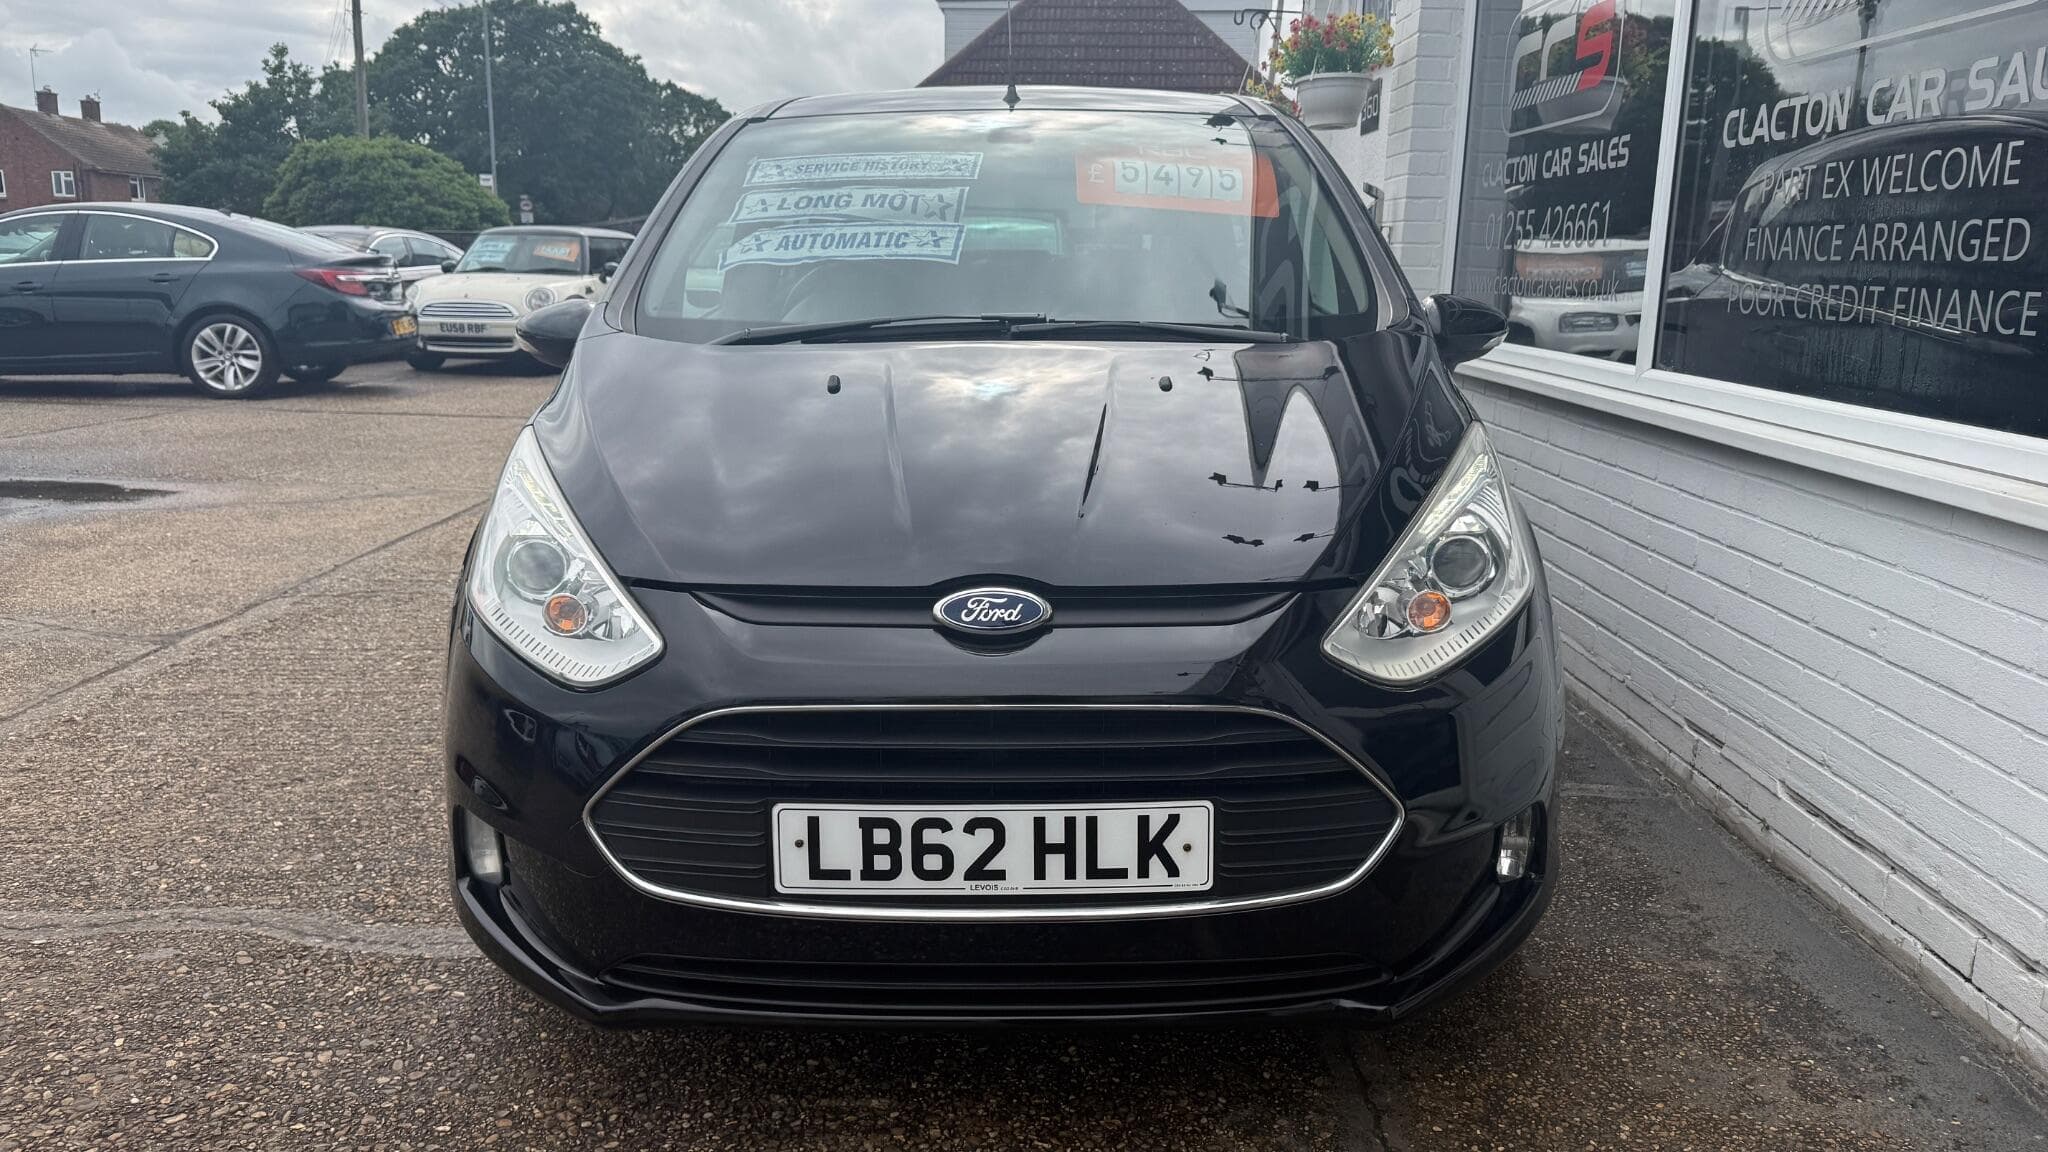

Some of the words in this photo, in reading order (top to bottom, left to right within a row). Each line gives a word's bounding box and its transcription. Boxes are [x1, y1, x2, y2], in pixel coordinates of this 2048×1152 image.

[1722, 86, 1854, 149] CLACTON
[1866, 67, 1947, 126] CAR
[794, 161, 859, 175] SERVICE
[865, 159, 929, 173] HISTORY
[1482, 153, 1538, 188] CLACTON
[1542, 146, 1572, 179] CAR
[1577, 134, 1631, 174] SALES
[1762, 164, 1818, 203] PART
[1822, 160, 1855, 199] EX
[1863, 140, 2025, 196] WELCOME
[776, 193, 854, 211] LONG
[861, 193, 922, 214] MOT
[1485, 208, 1536, 250] 01255
[1539, 200, 1611, 249] 426661
[774, 231, 911, 252] AUTOMATIC
[1744, 224, 1846, 262] FINANCE
[1850, 217, 2031, 262] ARRANGED
[439, 321, 465, 333] EU58
[1727, 283, 1786, 317] POOR
[1794, 283, 1886, 324] CREDIT
[1892, 287, 2042, 337] FINANCE
[960, 597, 1024, 622] Ford
[806, 815, 1007, 882] LB62
[1033, 813, 1181, 881] HLK
